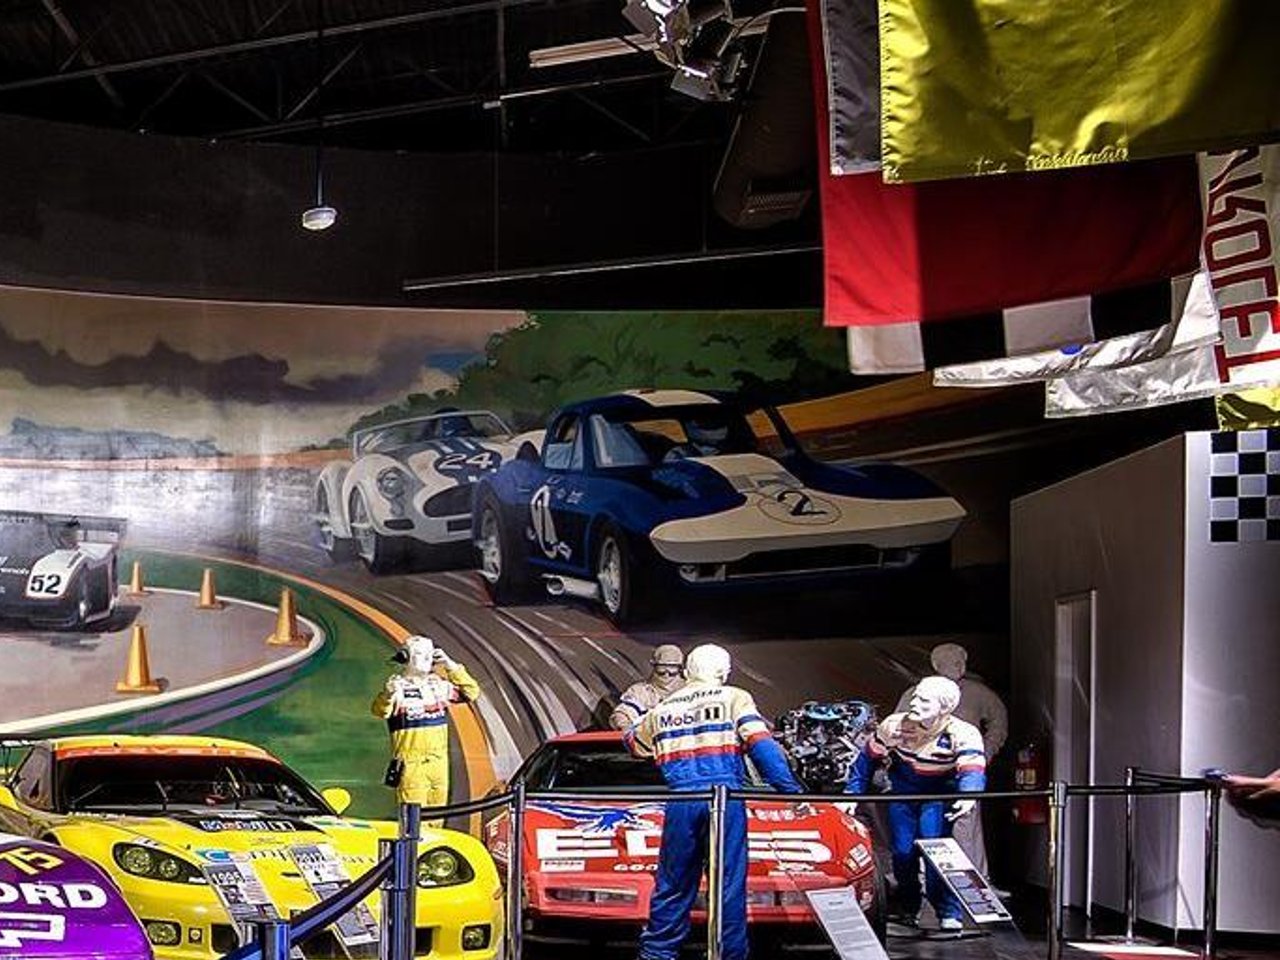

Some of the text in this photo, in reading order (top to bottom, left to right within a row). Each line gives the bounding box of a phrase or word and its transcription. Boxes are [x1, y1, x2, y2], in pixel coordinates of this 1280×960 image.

[438, 452, 494, 470] 24
[777, 490, 828, 517] 2
[29, 574, 62, 595] 52
